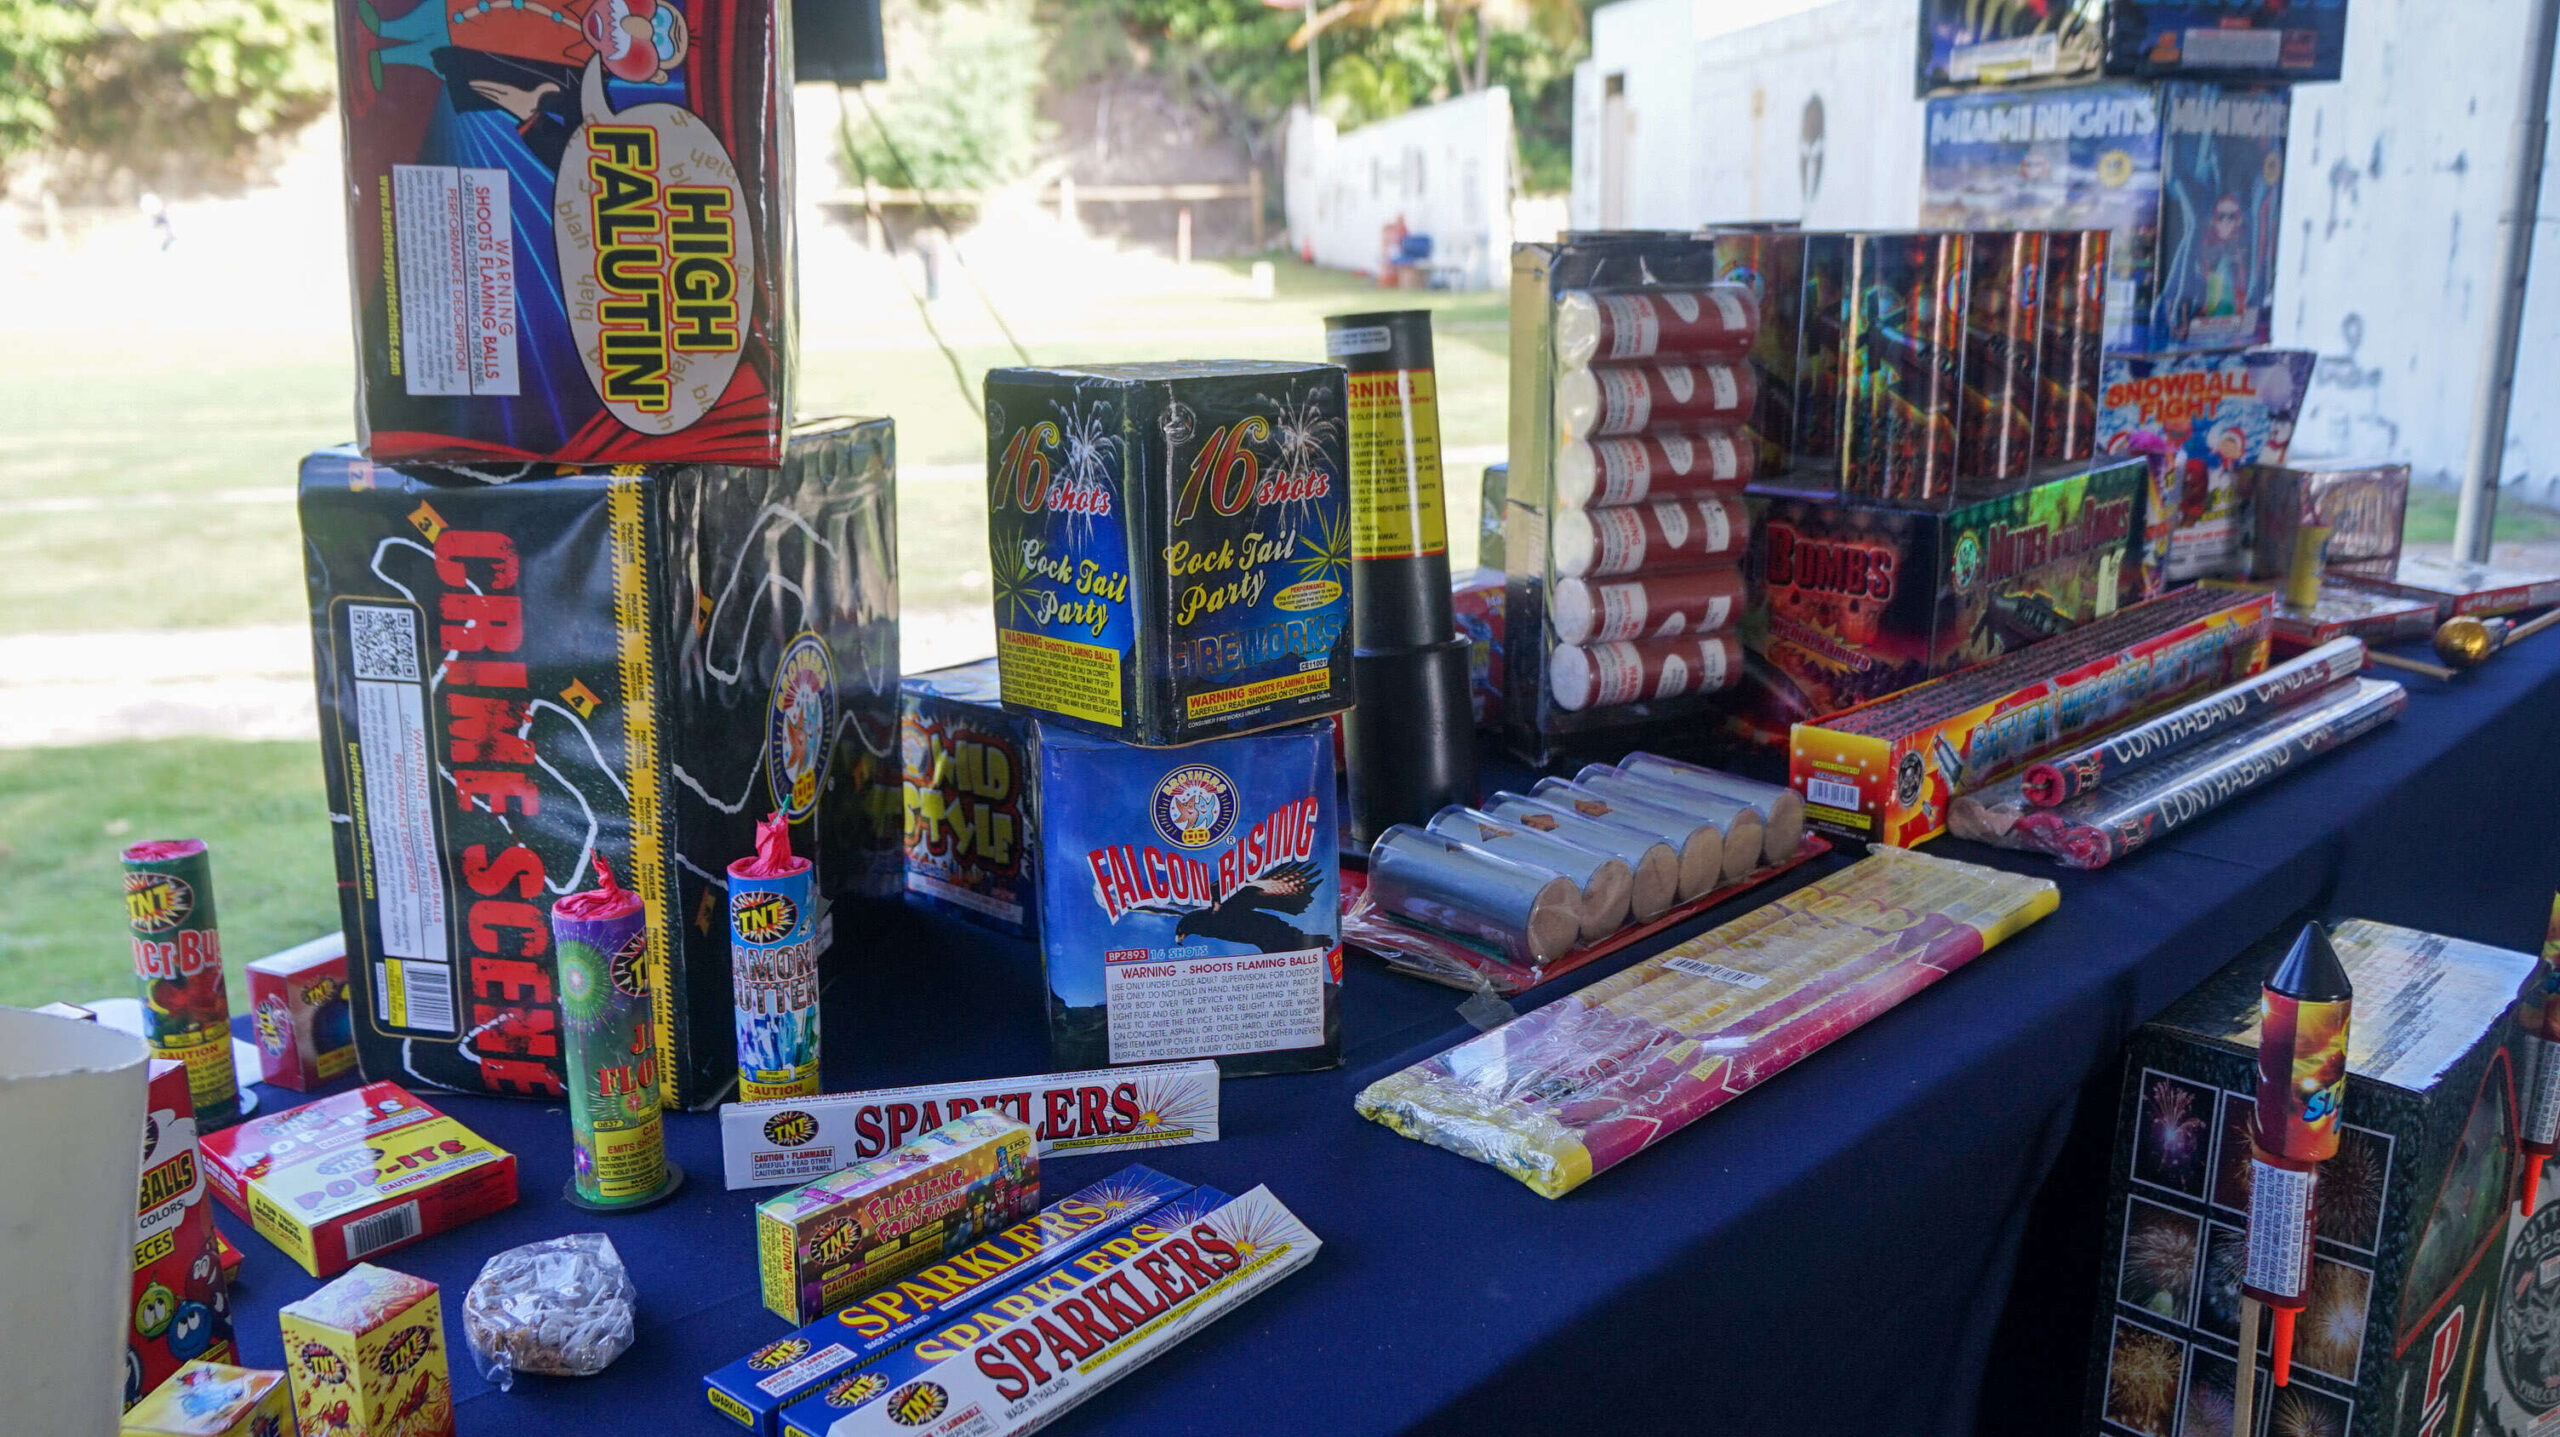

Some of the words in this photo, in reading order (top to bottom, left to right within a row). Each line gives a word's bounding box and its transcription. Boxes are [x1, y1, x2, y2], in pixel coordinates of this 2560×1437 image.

[1931, 104, 2032, 146] MIAMI
[2033, 95, 2157, 143] NIGHTS
[463, 174, 476, 223] CAREFULLY
[475, 186, 494, 248] SHOOTS
[446, 188, 465, 284] PERFORMANCE
[466, 224, 477, 246] READ
[557, 201, 593, 251] blah
[379, 175, 402, 376] www.brotherspyrotechnics.com
[467, 250, 479, 278] OTHER
[588, 126, 672, 413] FALUTIN'
[664, 186, 740, 352] HIGH
[469, 281, 482, 323] WARNING
[479, 256, 497, 330] FLAMING
[496, 239, 514, 337] WARNING
[575, 273, 595, 323] blah
[453, 290, 468, 371] DESCRIPTION
[472, 341, 483, 358] SIDE
[482, 337, 500, 379] BALLS
[1348, 380, 1416, 399] RNING
[2105, 371, 2256, 408] SNOWBALL
[2139, 395, 2223, 424] FIGHT
[991, 420, 1060, 514] 16
[1047, 480, 1112, 515] shots
[1175, 415, 1270, 526] 16
[1258, 471, 1329, 505] shots
[418, 516, 433, 533] 3
[1022, 538, 1072, 584] Cock
[1077, 558, 1128, 604] Tail
[1163, 539, 1235, 577] Cock
[1240, 529, 1296, 570] Tail
[1766, 522, 1893, 600] BOMBS
[1987, 521, 2049, 585] MOTHER
[1176, 571, 1266, 626] Party
[1290, 582, 1326, 593] PERFORMANCE
[1037, 589, 1110, 637] Party
[1004, 631, 1043, 649] WARNING
[1045, 641, 1067, 653] SHOOTS
[1067, 645, 1093, 660] FLAMING
[1095, 650, 1113, 663] BALLS
[1175, 613, 1342, 677] FIREWORKS
[433, 530, 540, 816] CRIME
[1190, 689, 1245, 708] WARNING
[1248, 683, 1275, 697] SHOOTS
[1276, 677, 1306, 691] FLAMING
[1306, 671, 1328, 684] BALLS
[571, 694, 586, 709] 4
[1189, 704, 1227, 718] CAREFULLY
[1228, 700, 1245, 710] READ
[1246, 693, 1278, 706] WARNINGS
[1279, 690, 1288, 698] ON
[1289, 686, 1308, 696] OTHER
[1309, 682, 1328, 692] PANEL
[1216, 713, 1244, 724] FIREWORKS
[2112, 694, 2247, 763] CONTRABAND
[2254, 663, 2326, 704] CANDLE
[412, 728, 428, 800] WARNING
[931, 733, 1010, 800] WILD
[1162, 770, 1227, 796] BROTHERS
[392, 752, 409, 831] PERFORMANCE
[2158, 745, 2291, 828] CONTRABAND
[348, 742, 376, 900] brotherspyrotechnics.com
[419, 808, 434, 847] SHOOTS
[400, 833, 418, 894] DESCRIPTION
[424, 849, 438, 890] FLAMING
[1087, 844, 1213, 926] FALCON
[1218, 795, 1319, 905] RISING
[126, 883, 174, 918] TNT
[430, 892, 442, 924] BALLS
[738, 901, 783, 935] TNT
[460, 845, 569, 1094] SCENE
[731, 938, 818, 982] AMON
[1108, 950, 1147, 961] BP2893
[1121, 965, 1176, 979] WARNING
[1189, 963, 1233, 975] SHOOTS
[1236, 958, 1286, 971] FLAMING
[1290, 954, 1318, 967] BALLS
[1150, 950, 1165, 960] 16
[1168, 945, 1208, 959] SHOTS
[1112, 982, 1125, 991] USE
[1126, 981, 1145, 991] ONLY
[1146, 979, 1170, 989] UNDER
[1172, 977, 1196, 987] CLOSE
[1197, 975, 1218, 986] ADULT
[1269, 971, 1284, 979] FOR
[1286, 967, 1320, 978] OUTDOOR
[158, 1043, 219, 1060] CAUTION
[746, 1083, 804, 1097] CAUTION
[238, 1099, 403, 1168] POP-ITS
[608, 1143, 636, 1155] EMITS
[774, 1117, 808, 1141] TNT
[294, 1139, 466, 1210] POP-ITS
[754, 1153, 784, 1163] CAUTION
[787, 1150, 832, 1160] FLAMMABLE
[754, 1160, 790, 1170] CAREFULLY
[792, 1159, 809, 1167] READ
[810, 1157, 832, 1165] OTHER
[754, 1168, 784, 1178] CAUTIONS
[785, 1167, 796, 1175] ON
[796, 1166, 811, 1174] SIDE
[139, 1154, 193, 1211] BALLS
[381, 1172, 429, 1192] CAUTION:
[865, 1168, 965, 1226] FLASHING
[140, 1199, 184, 1230] COLORS
[255, 1205, 276, 1224] NOISE
[277, 1221, 303, 1243] MAKER
[278, 1212, 299, 1231] TRICK
[876, 1191, 962, 1244] FOUNTAIN
[134, 1236, 173, 1269] ECES
[781, 1227, 793, 1272] CAUTION
[819, 1224, 852, 1261] TNT
[824, 1268, 867, 1295] CAUTION
[837, 1198, 1108, 1339] SPARKLERS
[864, 1335, 887, 1350] MADE
[894, 1314, 930, 1336] THAILAND
[974, 1222, 1242, 1403] SPARKLERS
[310, 1355, 337, 1374] TNT
[389, 1334, 420, 1366] TNT
[760, 1368, 793, 1388] CAUTION
[798, 1345, 841, 1369] FLAMMABLE
[763, 1343, 797, 1368] TNT
[779, 1378, 831, 1411] CAUTION
[841, 1339, 908, 1379] FLAMMABLE
[840, 1376, 874, 1404] TNT
[711, 1389, 751, 1422] SPARKLERS
[901, 1385, 936, 1421] TNT
[1004, 1402, 1029, 1420] MADE
[1034, 1377, 1070, 1402] THAILAND
[940, 1406, 981, 1433] FLAMMABLE
